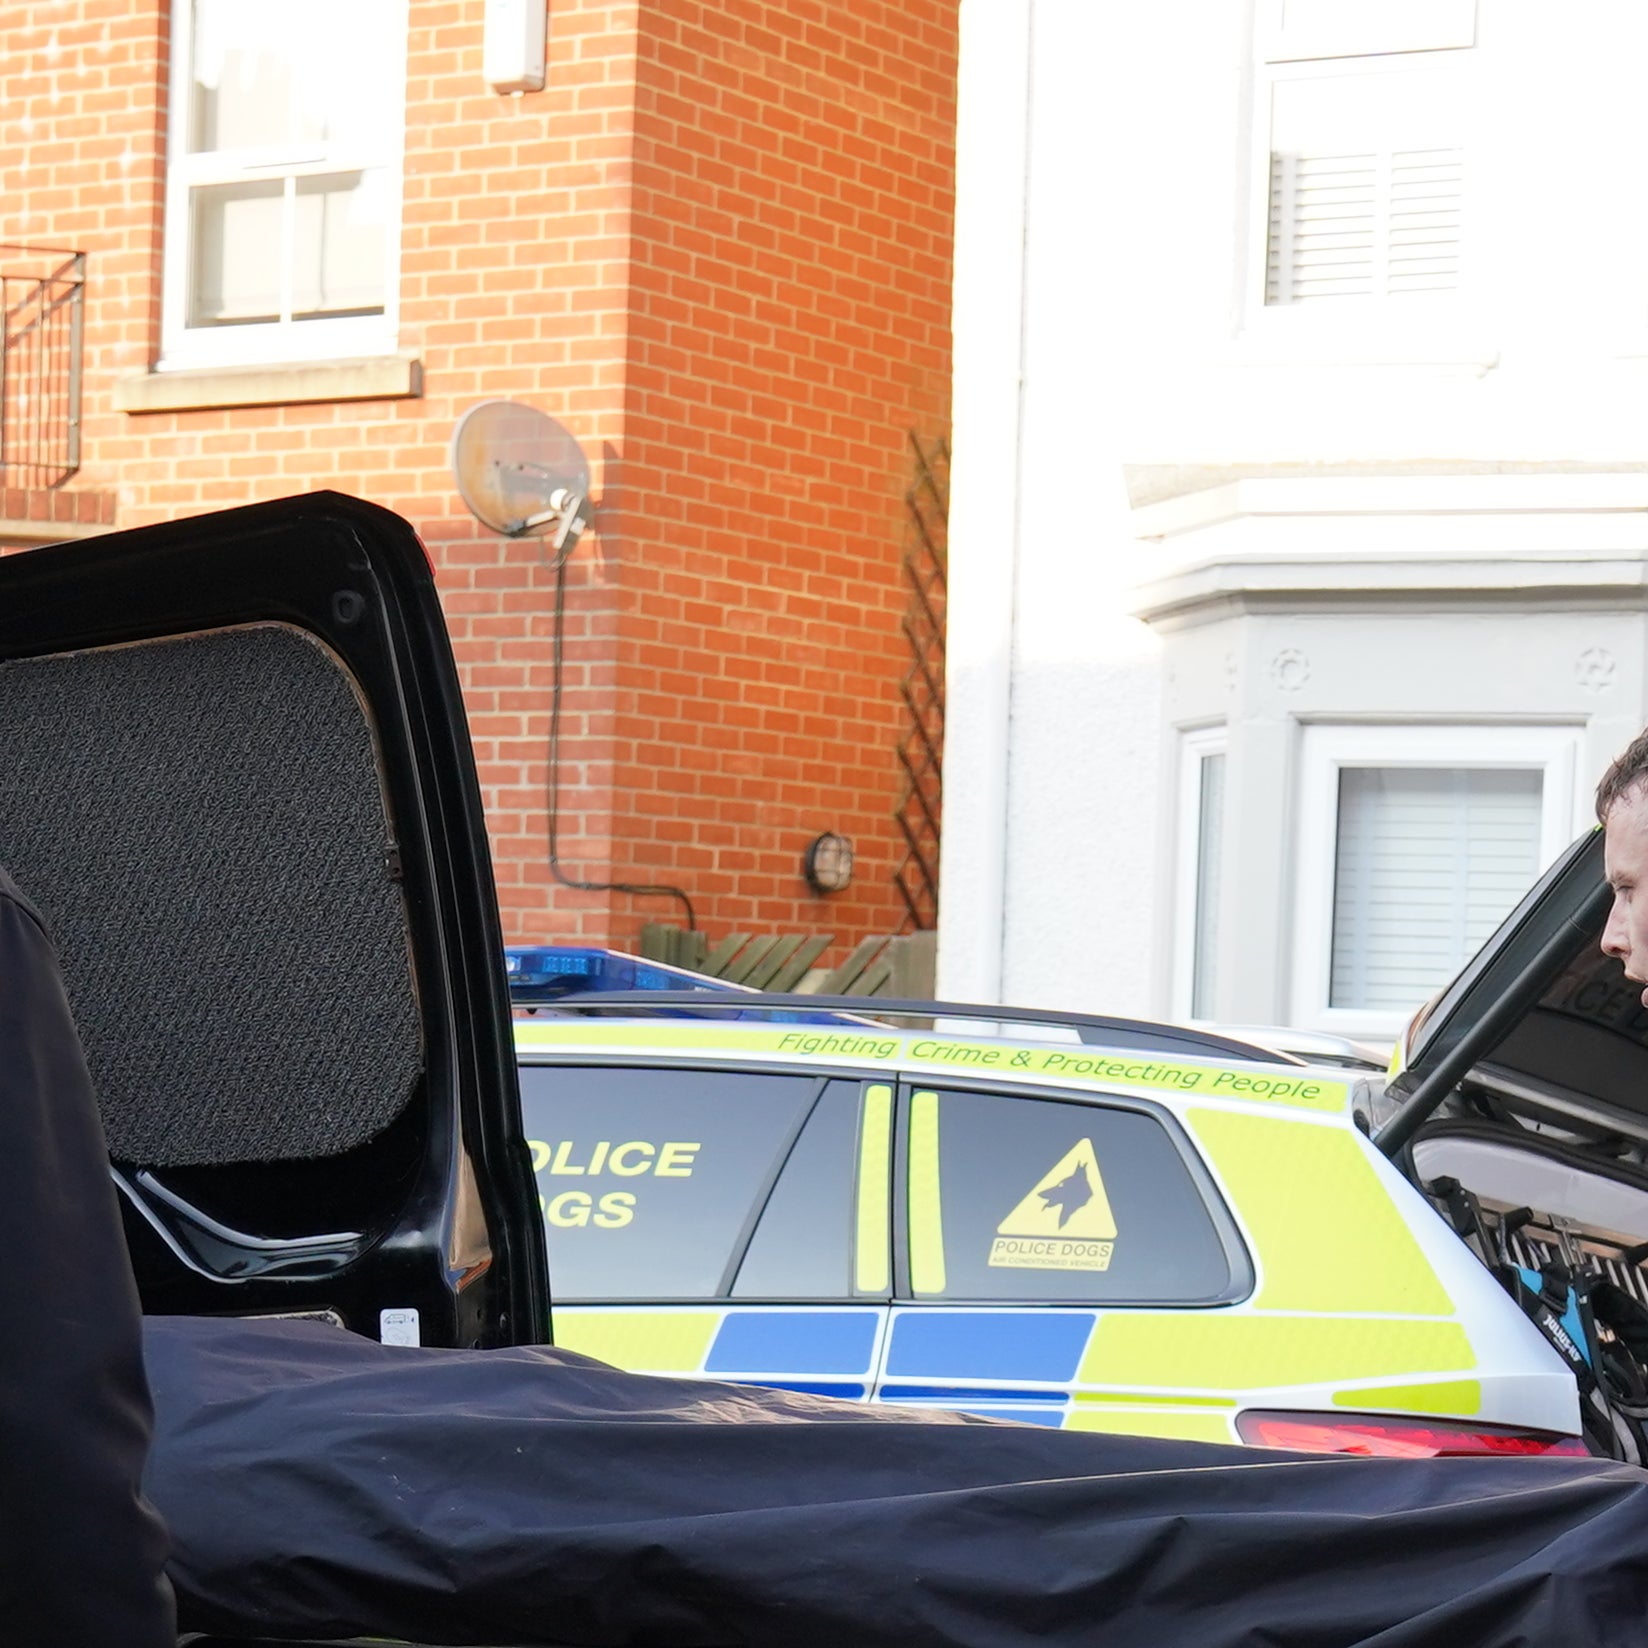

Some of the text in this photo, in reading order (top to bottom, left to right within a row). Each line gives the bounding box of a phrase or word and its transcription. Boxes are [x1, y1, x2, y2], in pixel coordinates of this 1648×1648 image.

[778, 1032, 1322, 1100] Fighting Crime & Protecting People
[539, 1191, 637, 1239] GS
[994, 1240, 1110, 1258] POLICE DOGS
